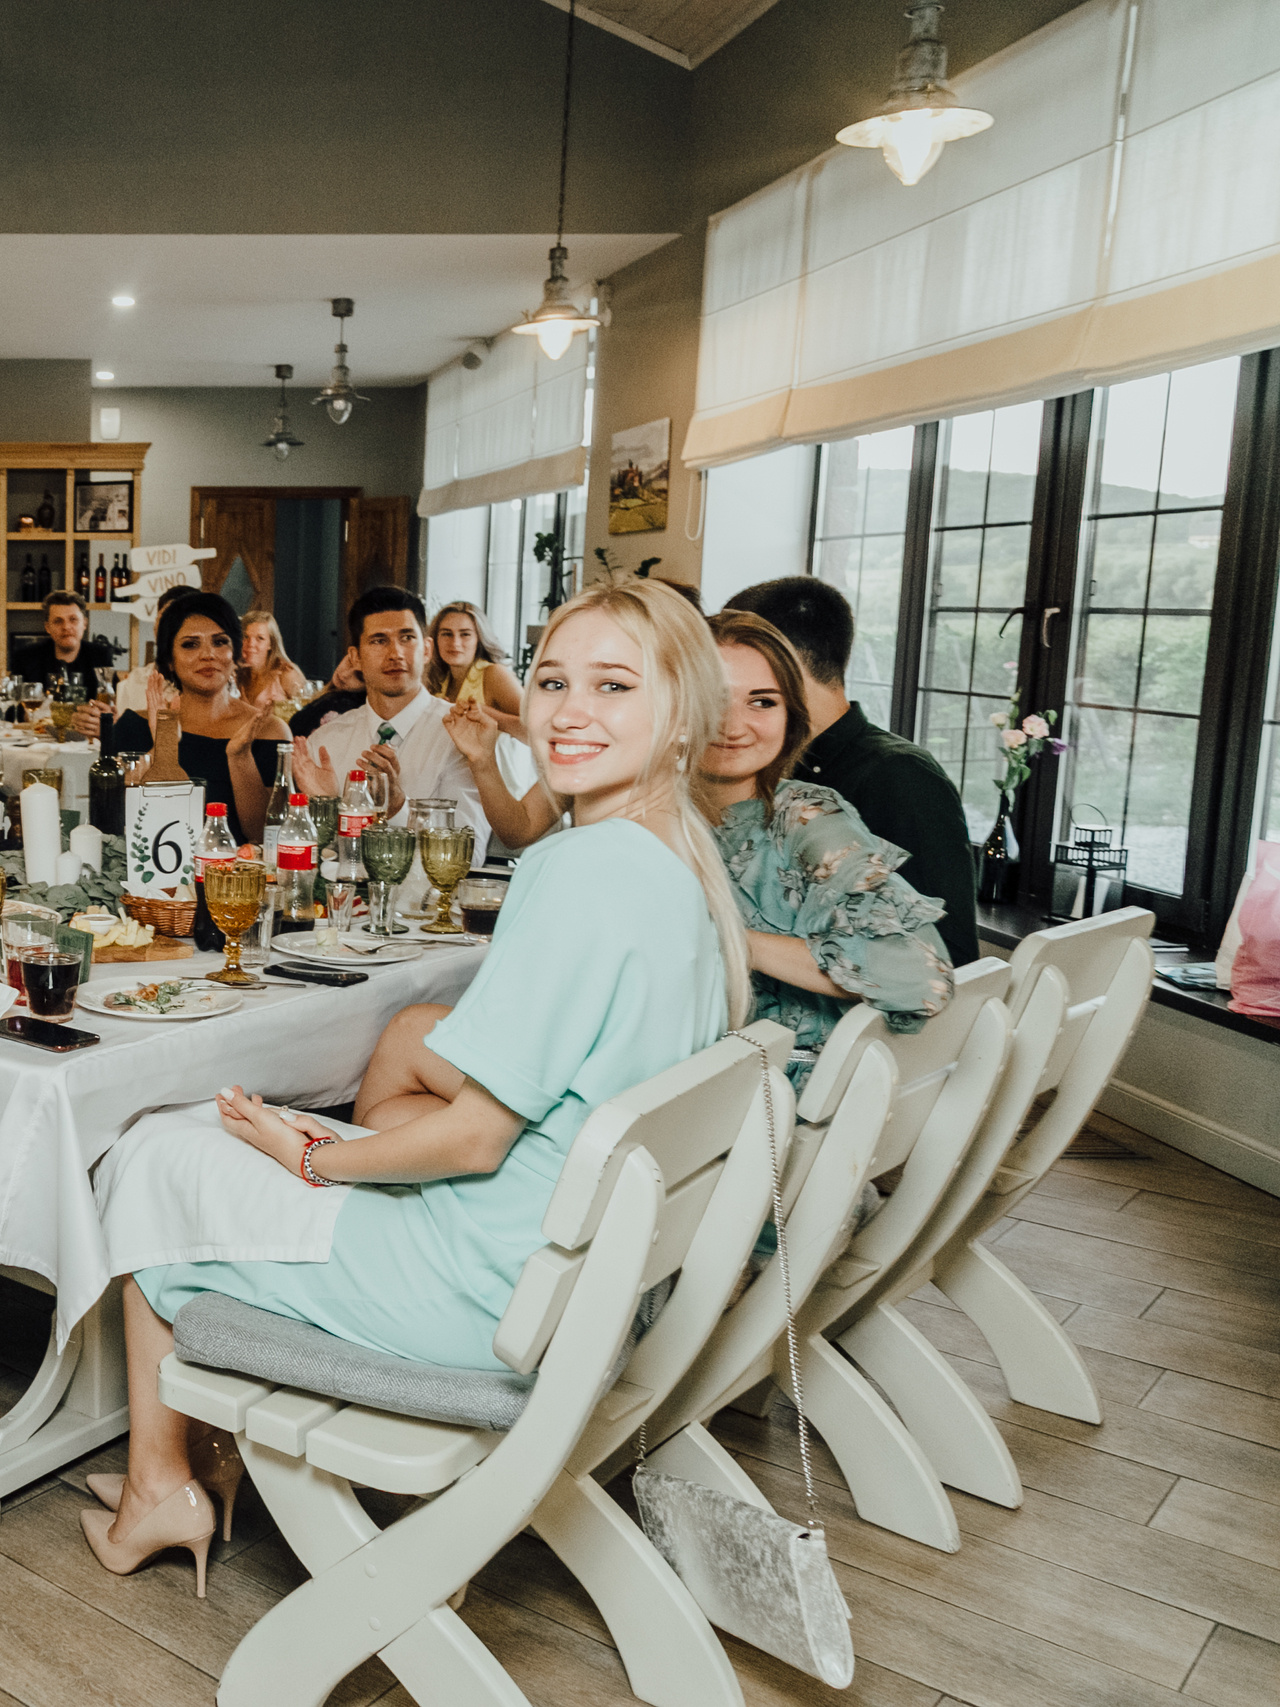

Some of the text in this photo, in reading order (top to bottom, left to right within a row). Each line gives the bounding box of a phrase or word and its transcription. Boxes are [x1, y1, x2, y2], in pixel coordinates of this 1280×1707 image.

[146, 549, 177, 566] VIDI
[147, 571, 187, 593] VINO
[151, 820, 183, 874] 6
